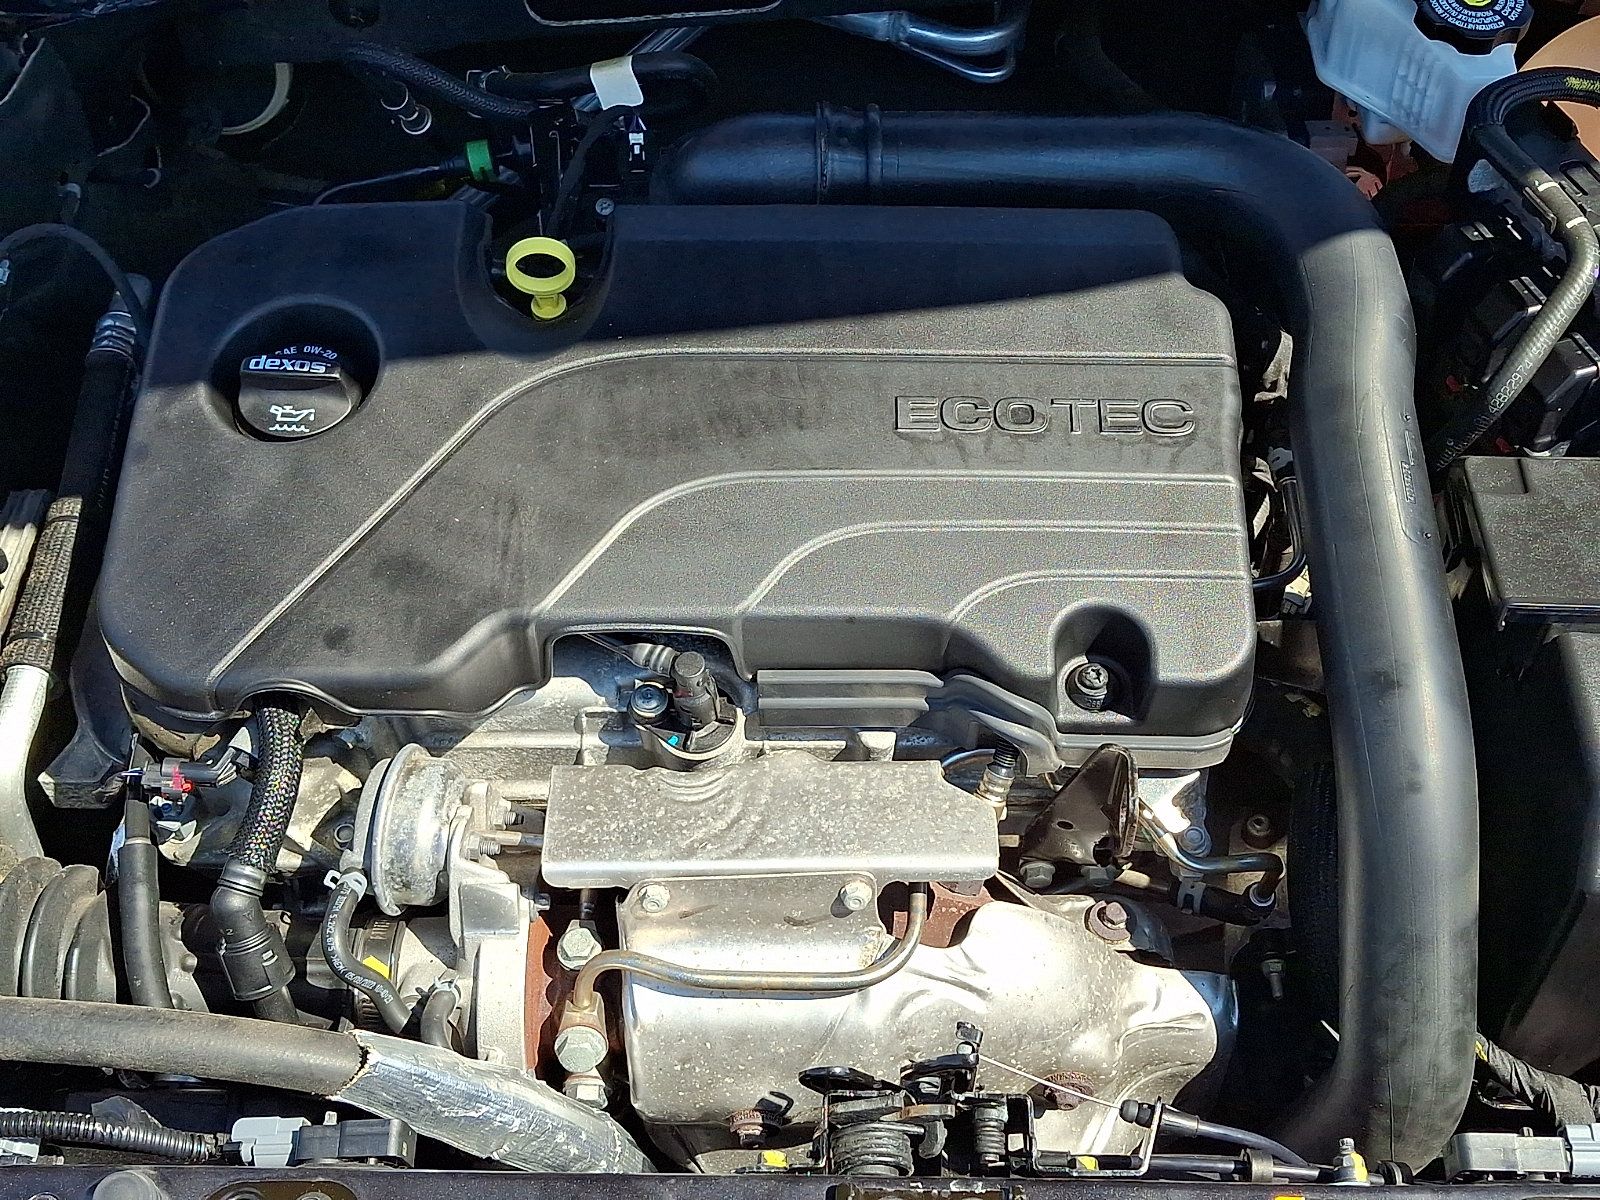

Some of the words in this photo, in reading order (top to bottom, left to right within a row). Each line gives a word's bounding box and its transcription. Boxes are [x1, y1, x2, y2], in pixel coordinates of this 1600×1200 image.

[249, 355, 327, 373] dexos
[1488, 358, 1533, 415] 42822974
[894, 396, 1196, 437] ECOTEC
